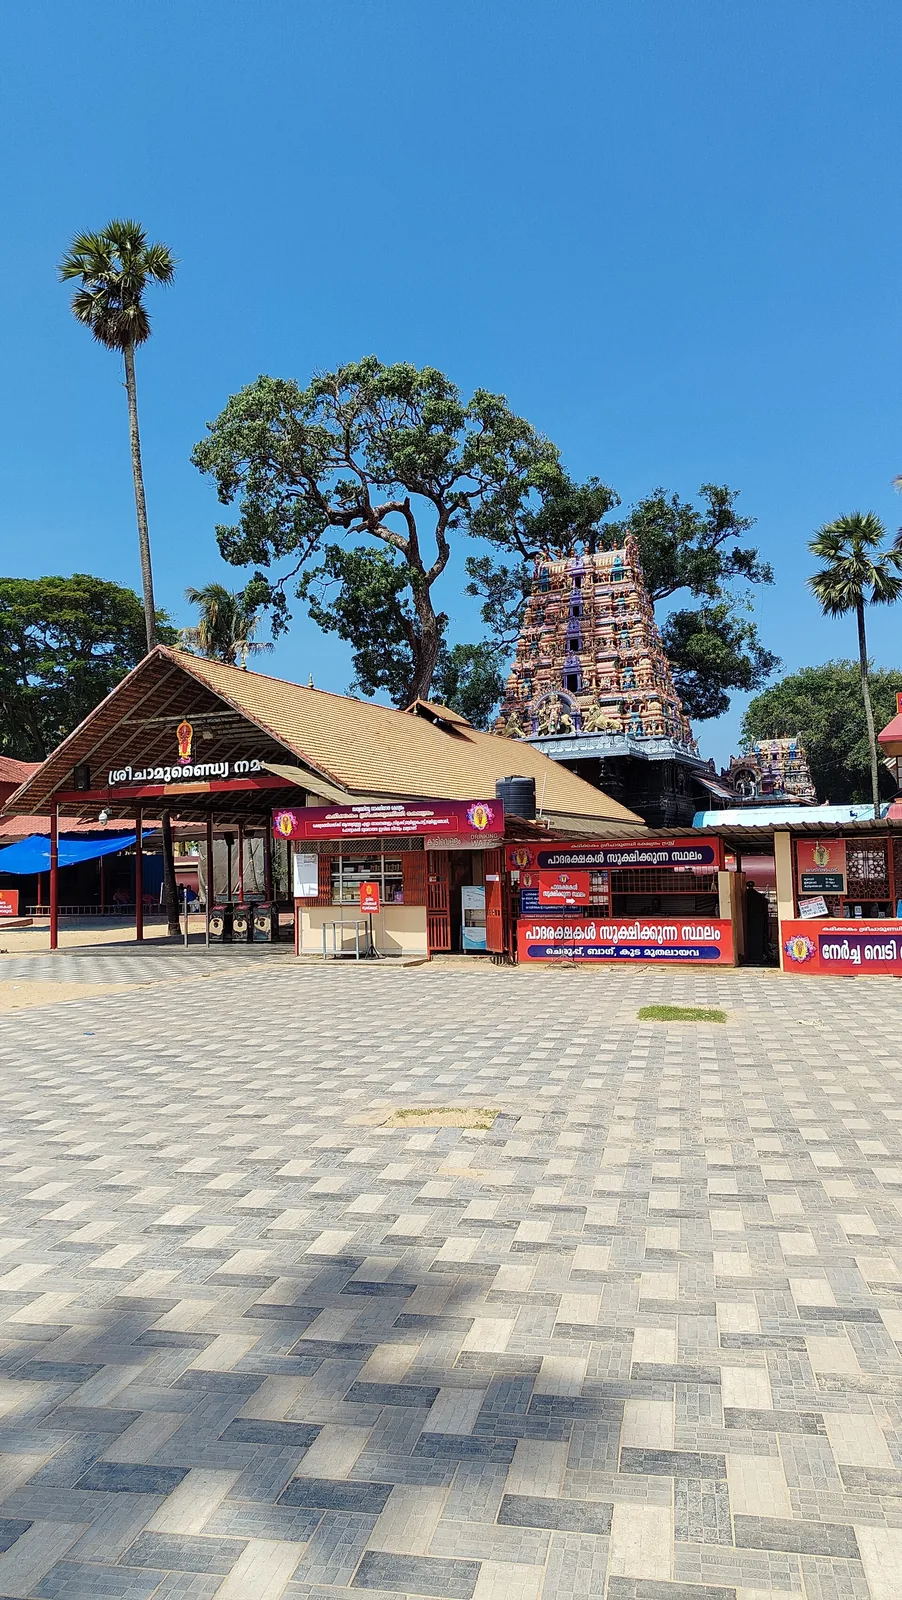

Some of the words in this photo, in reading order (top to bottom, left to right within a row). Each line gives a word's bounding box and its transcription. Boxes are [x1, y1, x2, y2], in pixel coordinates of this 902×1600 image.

[547, 851, 605, 865] പാദരക്ഷകൾ
[671, 850, 703, 862] സ്ഥലം
[526, 921, 597, 941] പാദരക്ഷകൾ
[682, 925, 721, 941] സ്ഥലം
[587, 946, 617, 957] ബാഗ്,
[619, 948, 641, 957] കുട
[644, 948, 700, 958] മുതലായവ
[822, 939, 863, 965] നേർച്ച
[864, 939, 898, 960] വെടി
